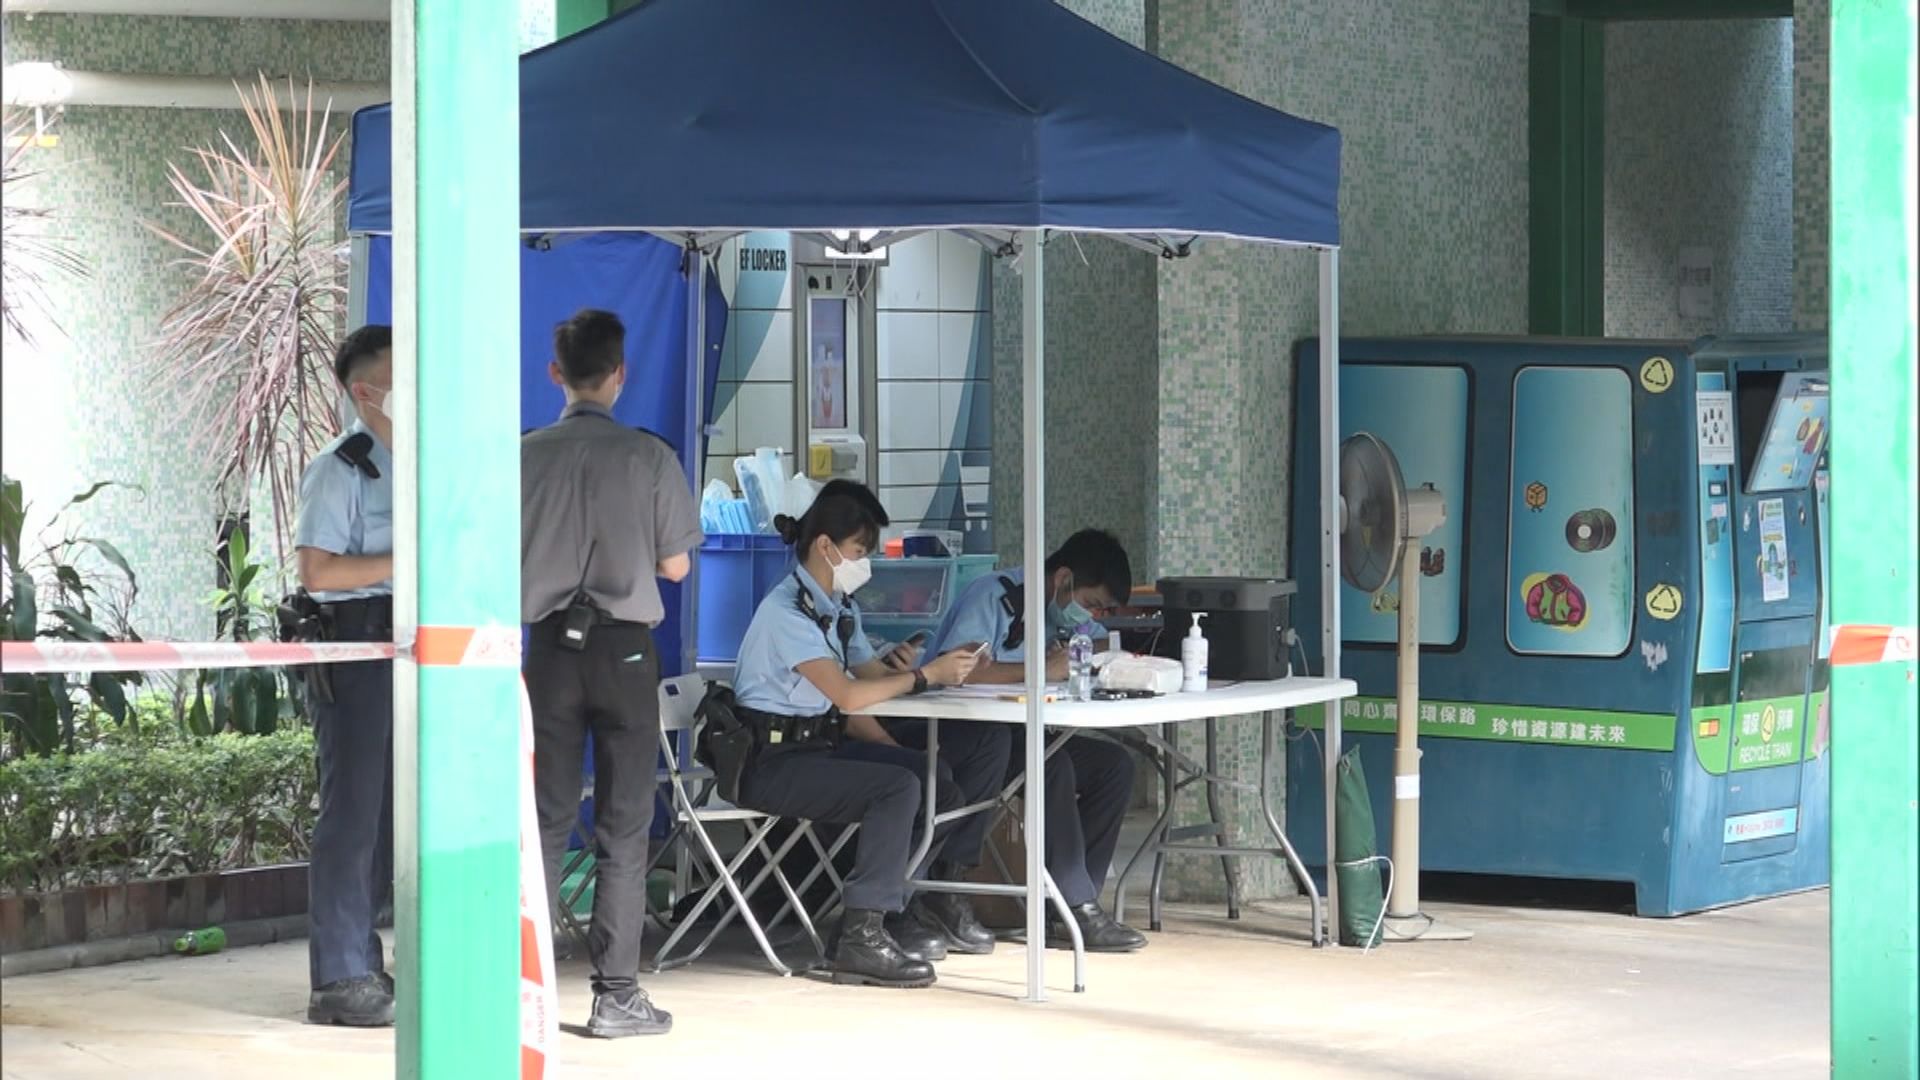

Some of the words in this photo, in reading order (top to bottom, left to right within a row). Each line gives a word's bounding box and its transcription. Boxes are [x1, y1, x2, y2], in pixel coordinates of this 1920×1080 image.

[740, 248, 750, 271] EF
[752, 248, 786, 271] LOCKER
[1344, 700, 1476, 725] 同心齊環保路
[1491, 717, 1626, 743] 珍惜資源建未來
[1739, 744, 1770, 764] RECYCLE
[1772, 742, 1793, 759] TRAIN
